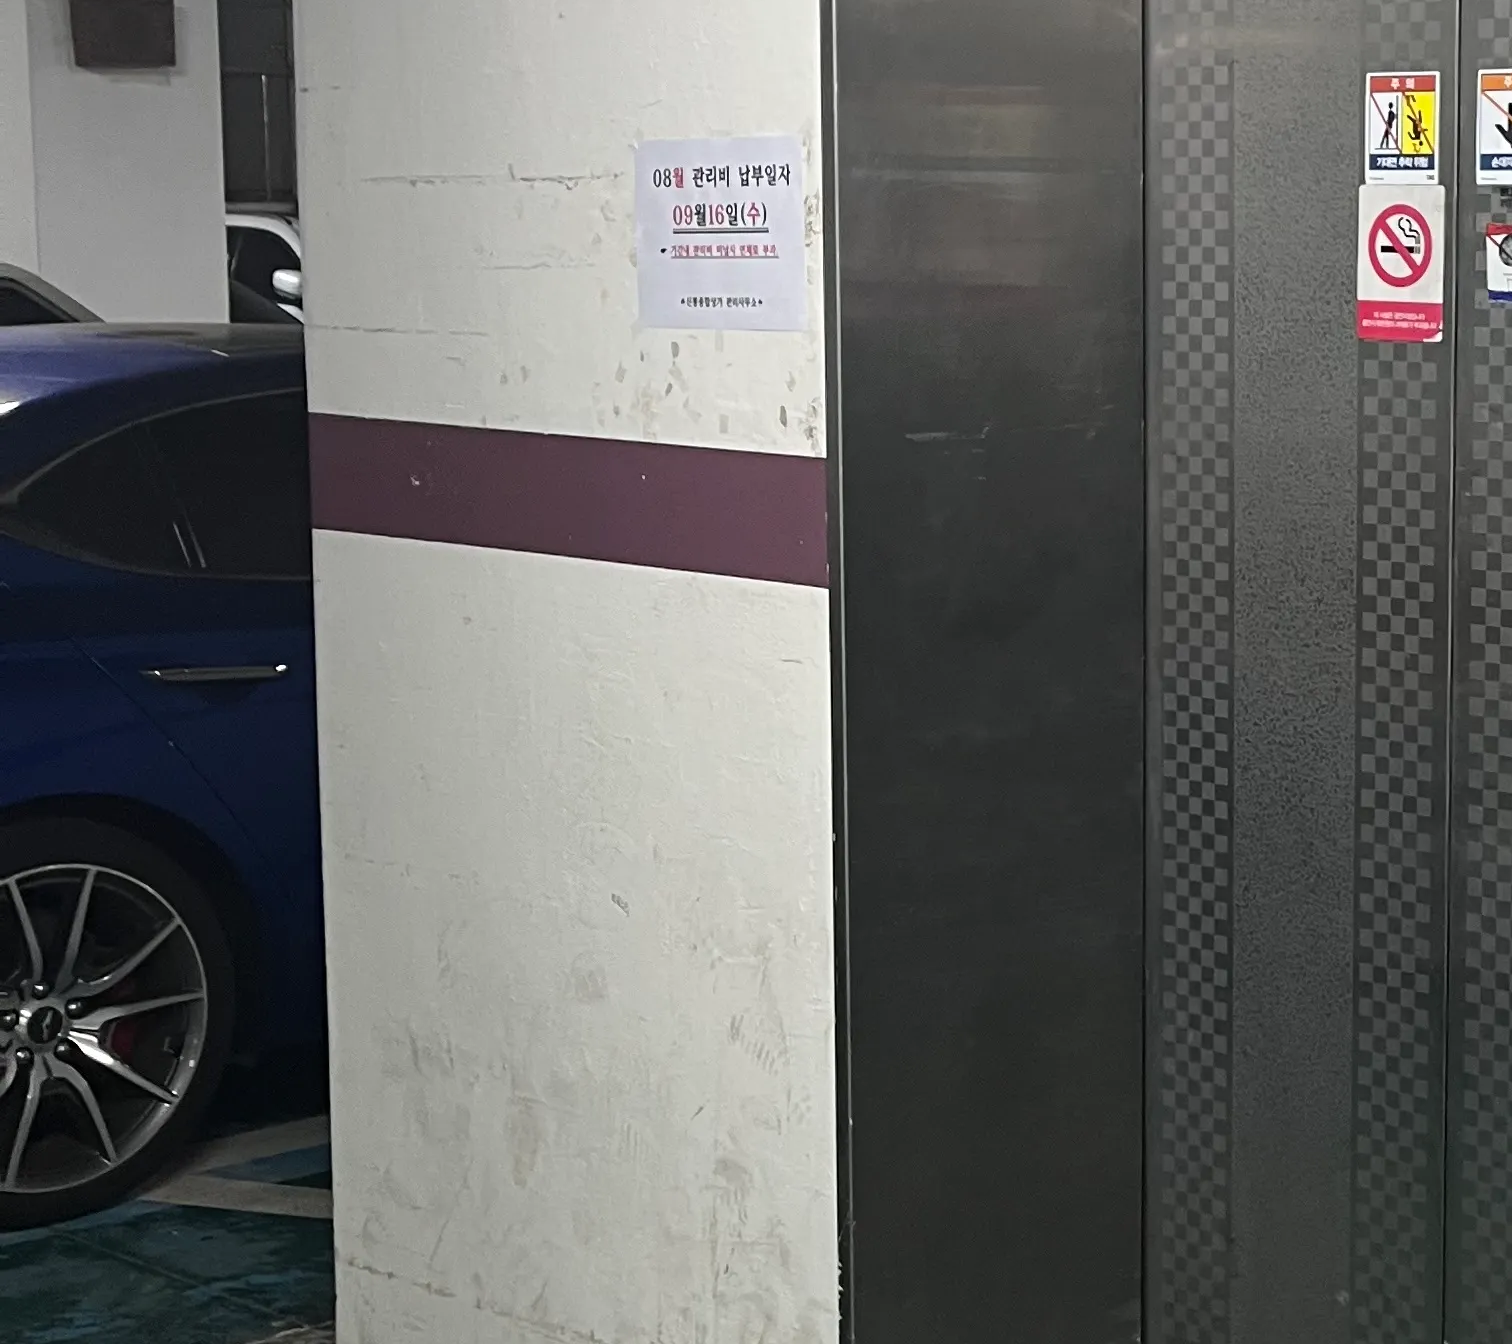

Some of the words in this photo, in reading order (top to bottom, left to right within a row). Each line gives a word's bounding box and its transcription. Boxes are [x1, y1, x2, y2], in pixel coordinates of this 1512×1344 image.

[653, 167, 684, 188] 08월
[692, 165, 730, 188] 관리비
[738, 164, 791, 187] 납부일자
[672, 202, 767, 227] 09월16일(수)
